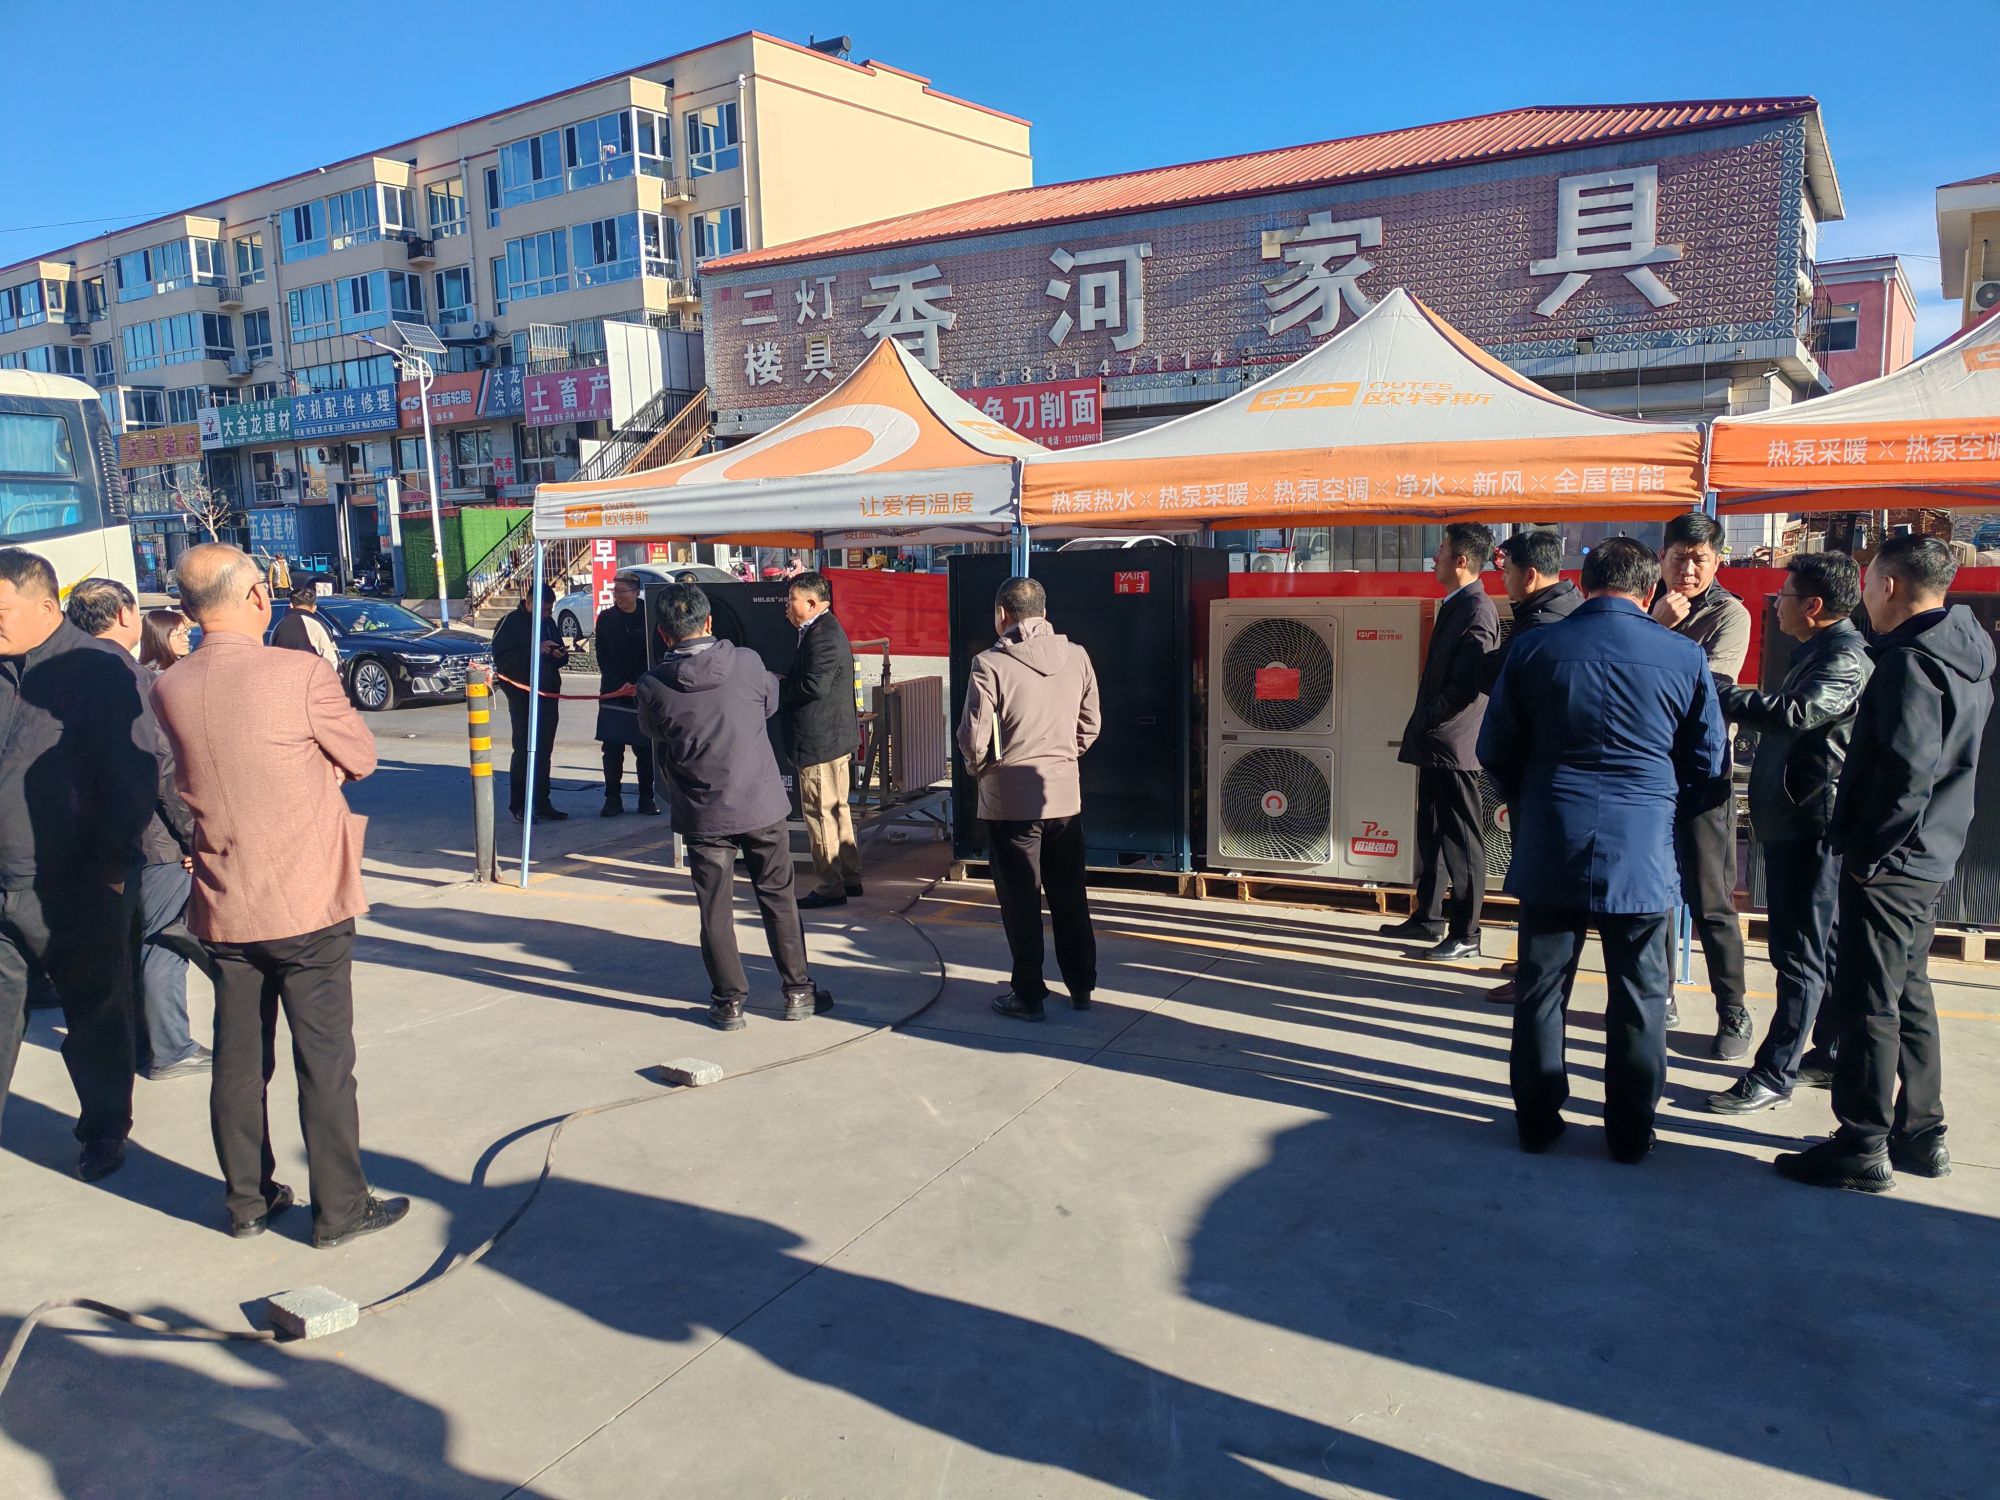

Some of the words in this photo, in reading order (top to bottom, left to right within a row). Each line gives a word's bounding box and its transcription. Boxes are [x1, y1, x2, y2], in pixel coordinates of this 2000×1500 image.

[861, 165, 1682, 369] 香河家具
[493, 366, 520, 386] 大龙
[295, 389, 391, 421] 农机配件修理
[431, 389, 472, 407] 正新轮胎
[496, 387, 522, 408] 汽修
[531, 372, 609, 412] 土畜产
[1362, 391, 1495, 406] 欧特斯
[223, 409, 291, 437] 大金龙建材
[1767, 437, 1868, 467] 热泵采暖
[1051, 488, 1136, 513] 热泵热水
[1158, 482, 1249, 509] 热泵采暖
[1273, 476, 1369, 504] 热泵空调
[1395, 473, 1446, 499] 净水
[1472, 470, 1525, 497] 新风
[1553, 465, 1665, 494] 全屋智能
[860, 491, 974, 517] 让爱有温度
[249, 512, 295, 540] 五金建材
[604, 511, 649, 526] 欧特斯
[1361, 820, 1389, 836] Pro
